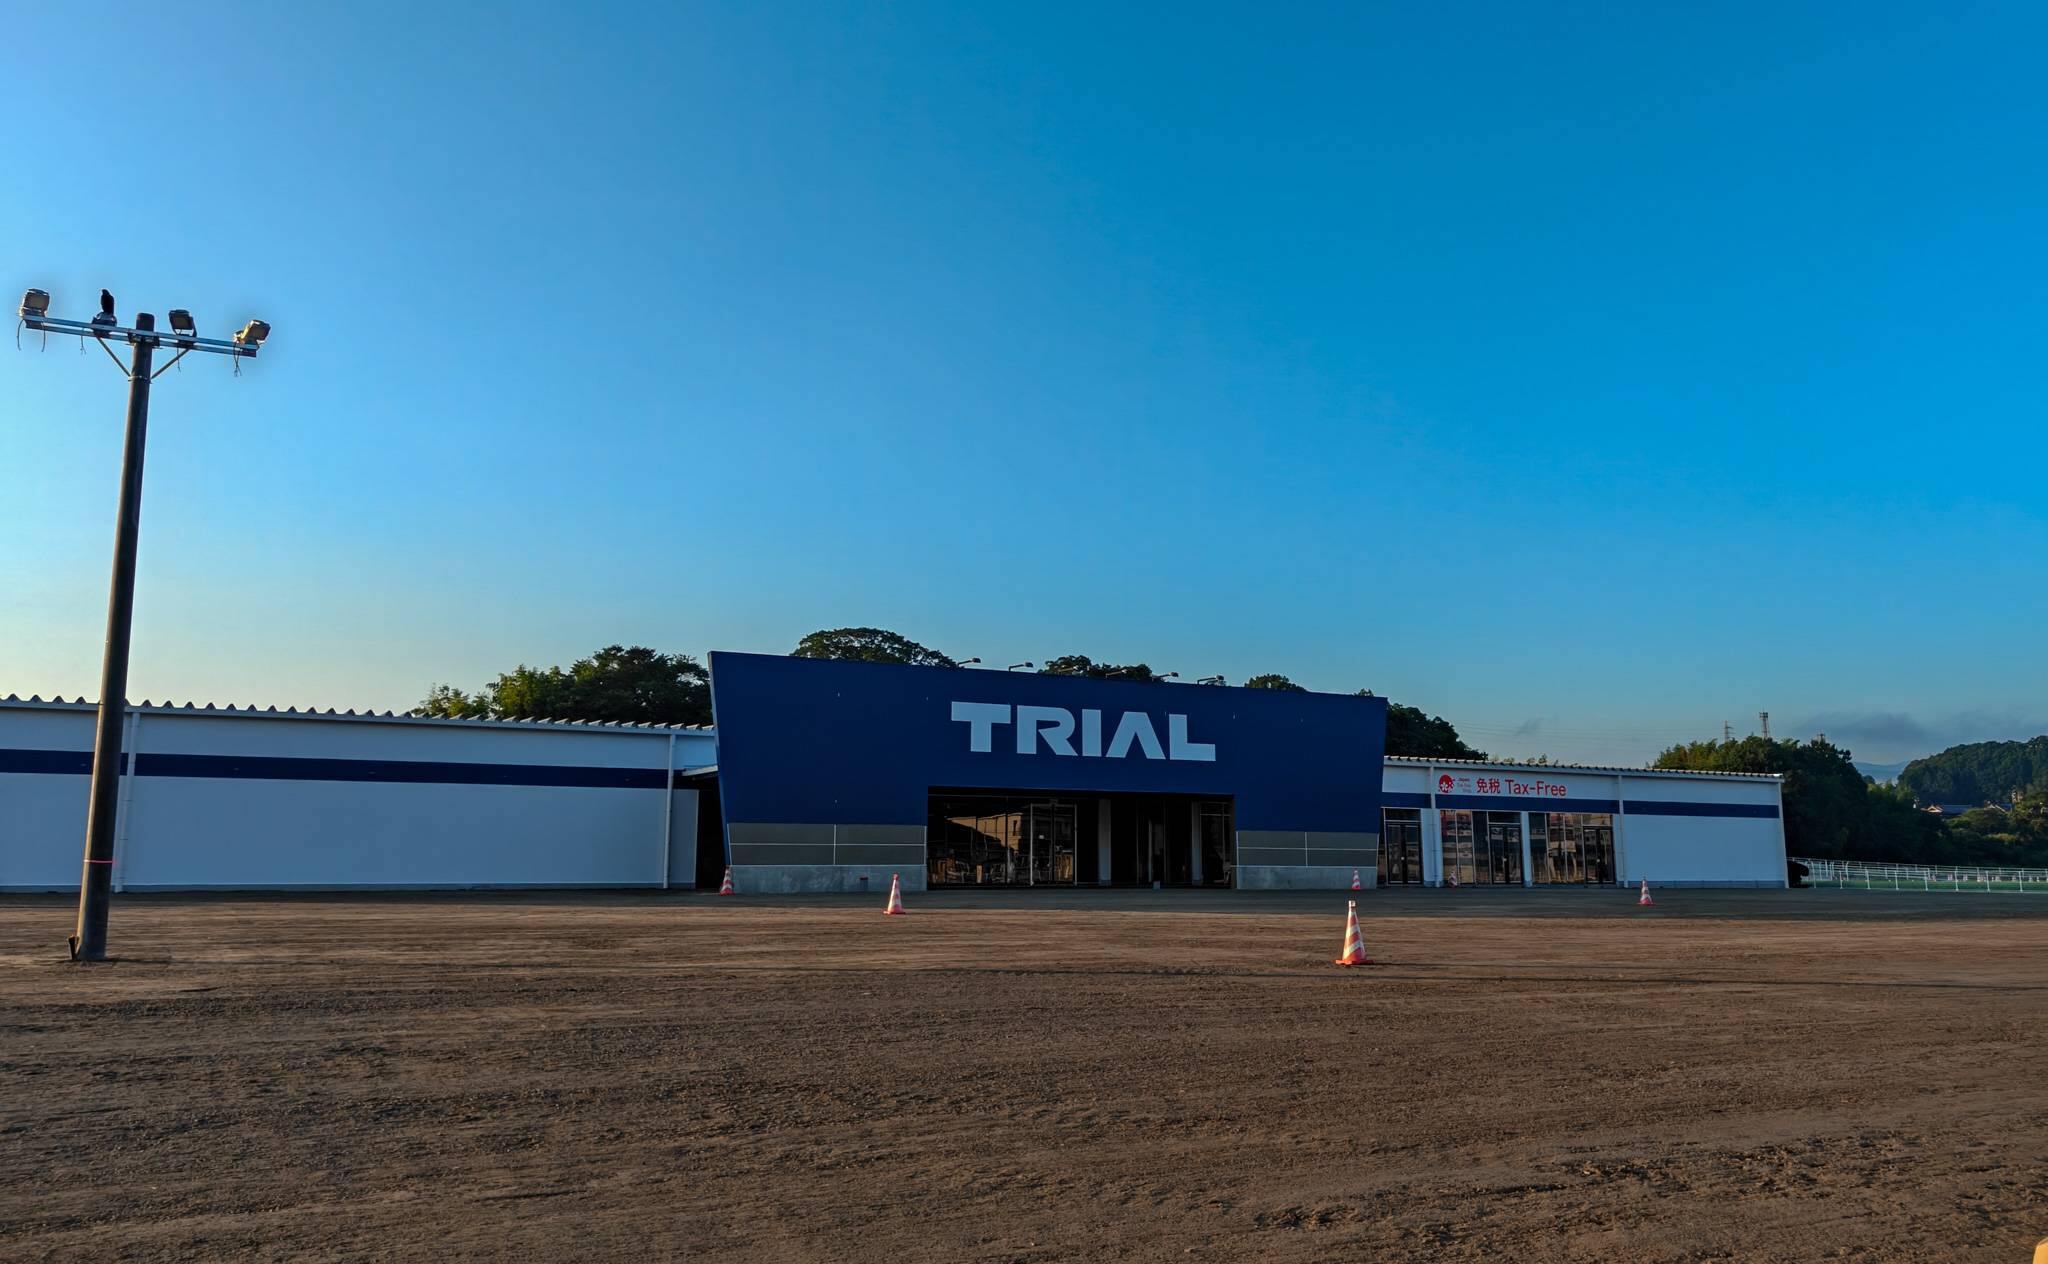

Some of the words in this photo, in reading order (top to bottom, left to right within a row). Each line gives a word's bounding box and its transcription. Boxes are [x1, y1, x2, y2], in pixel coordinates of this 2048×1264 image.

[951, 701, 1216, 762] TRIAL
[1476, 778, 1501, 794] 免税
[1505, 779, 1567, 797] Tax-Free
